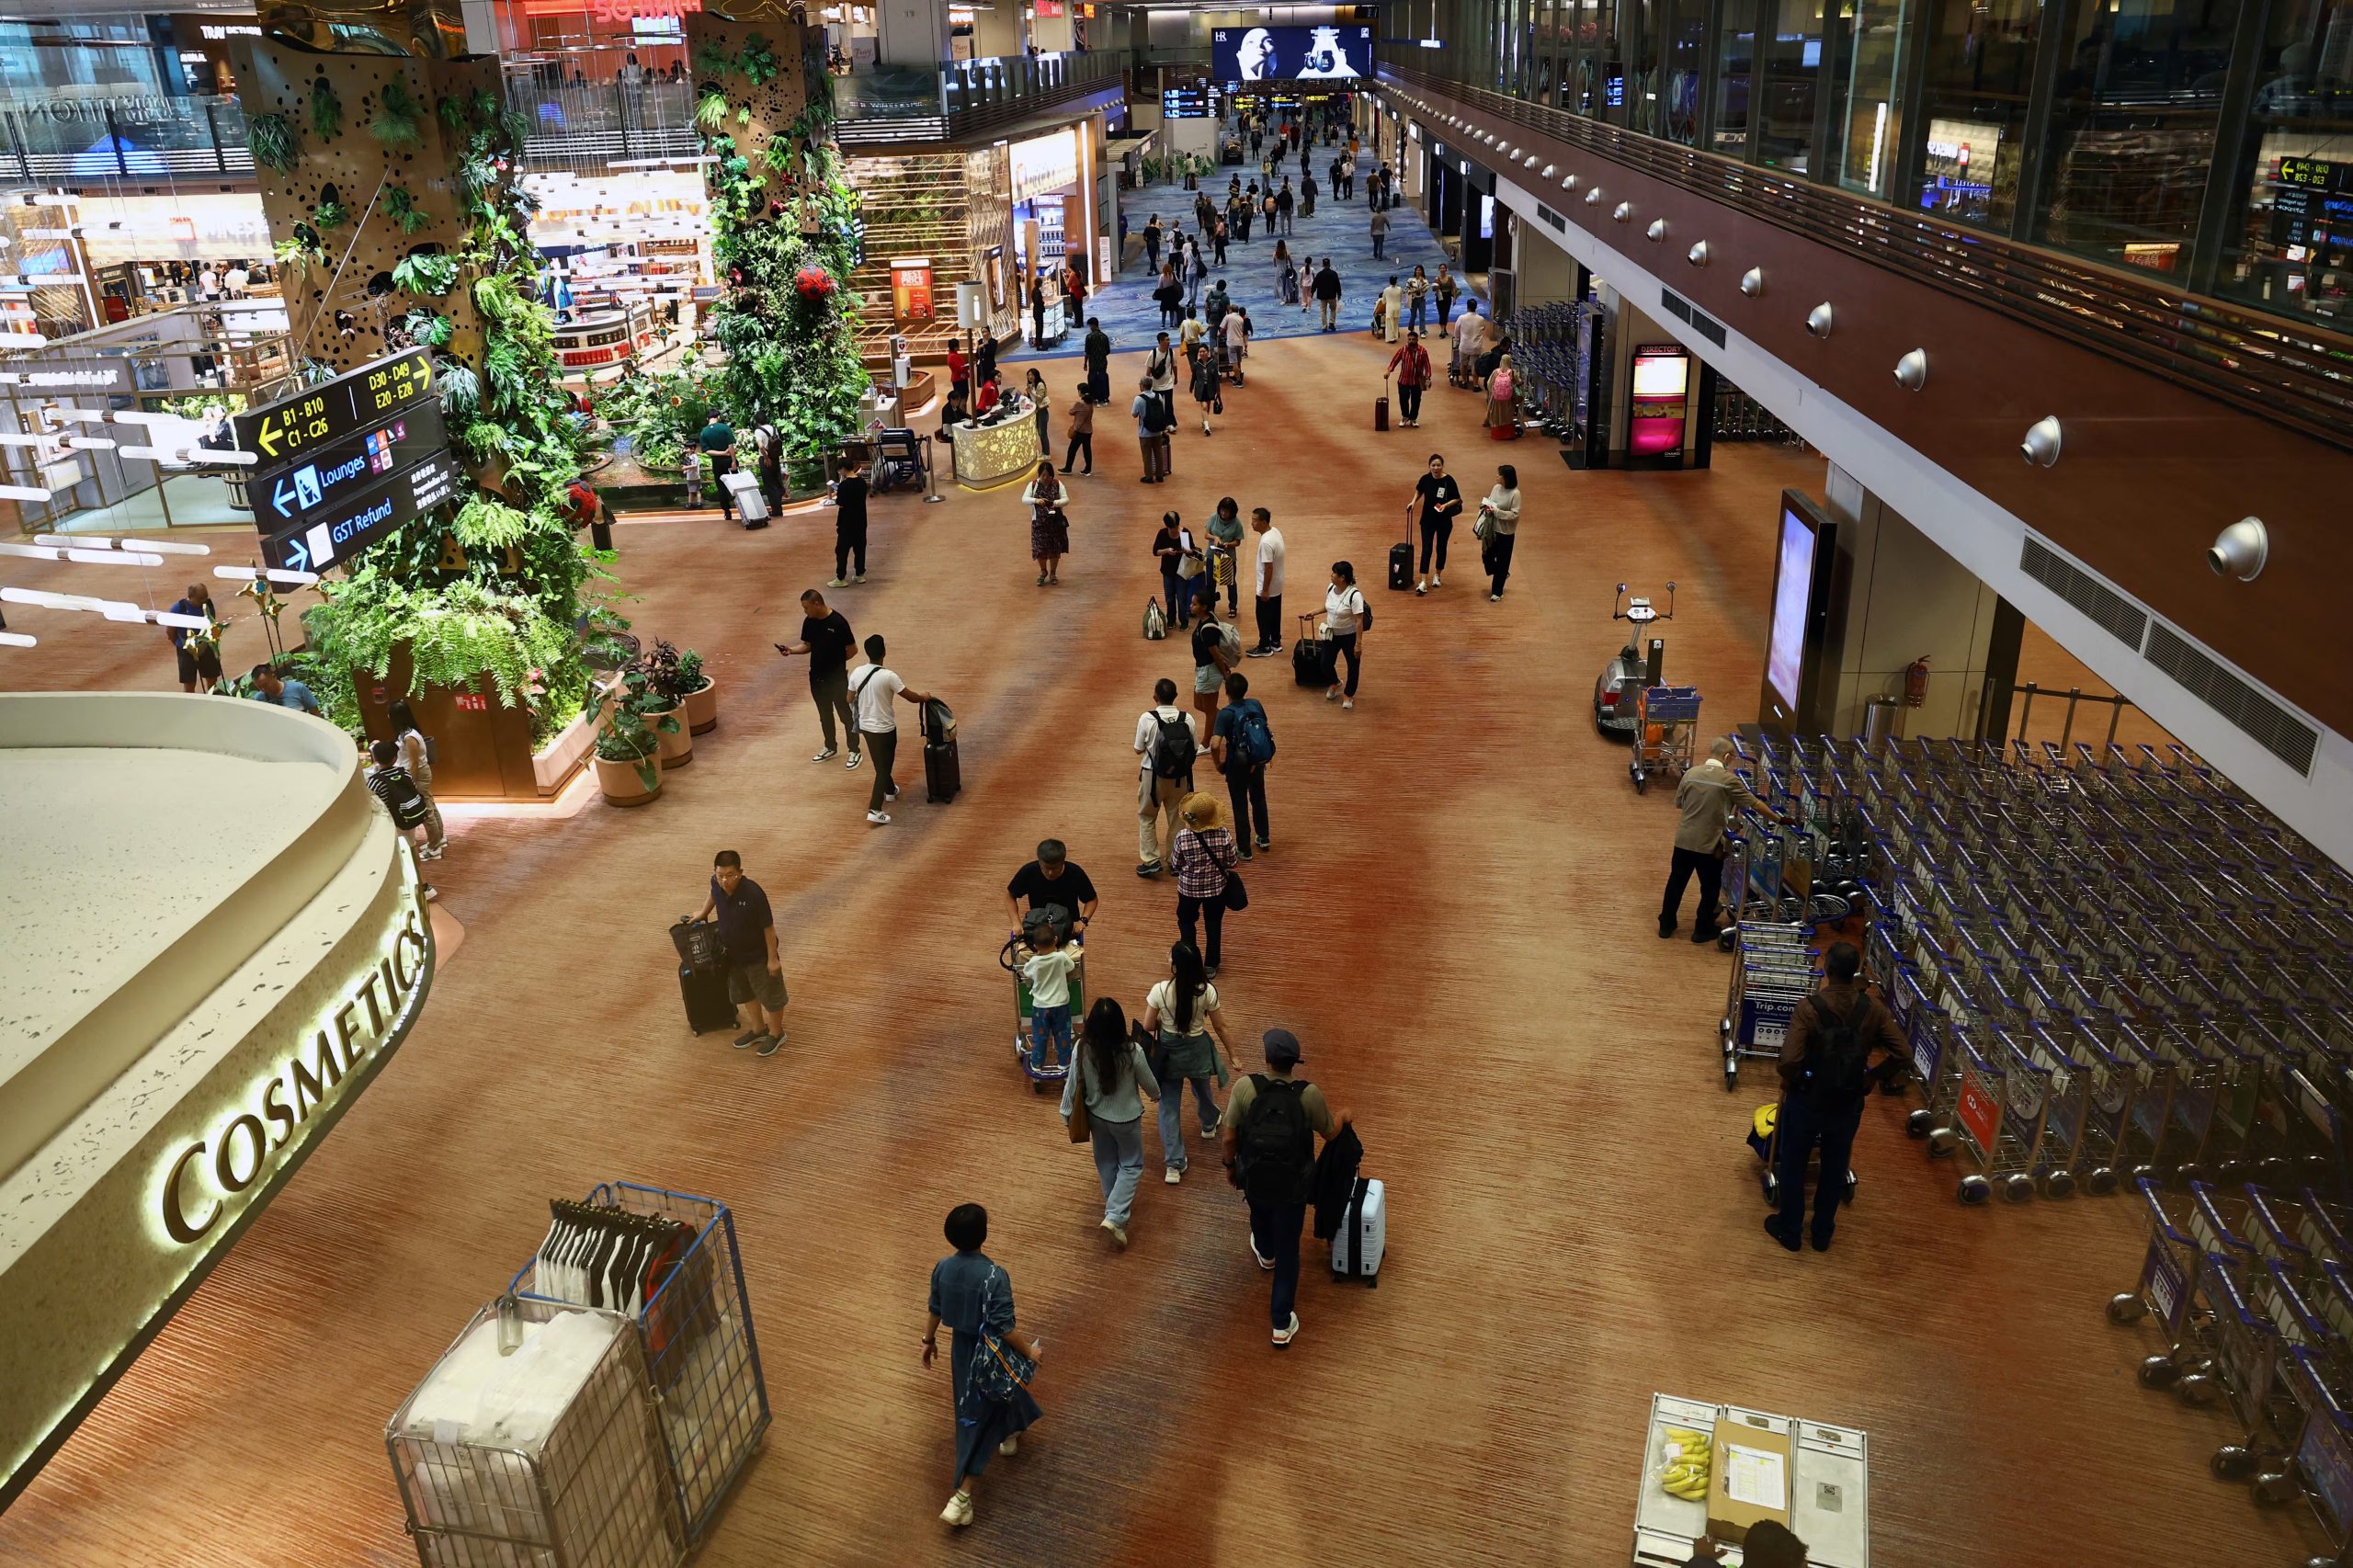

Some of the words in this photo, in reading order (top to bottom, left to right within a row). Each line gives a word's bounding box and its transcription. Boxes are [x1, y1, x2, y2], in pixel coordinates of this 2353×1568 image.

[369, 370, 387, 391] D30
[392, 362, 409, 382] D49
[376, 389, 392, 409] E20
[398, 381, 414, 401] E28
[282, 408, 297, 426] B1
[304, 397, 324, 417] B10
[288, 429, 301, 448] C1
[309, 418, 329, 439] C26
[321, 456, 366, 488] Lounges
[333, 520, 354, 544] GST
[357, 497, 392, 532] Refund
[162, 910, 426, 1244] COSMETICS
